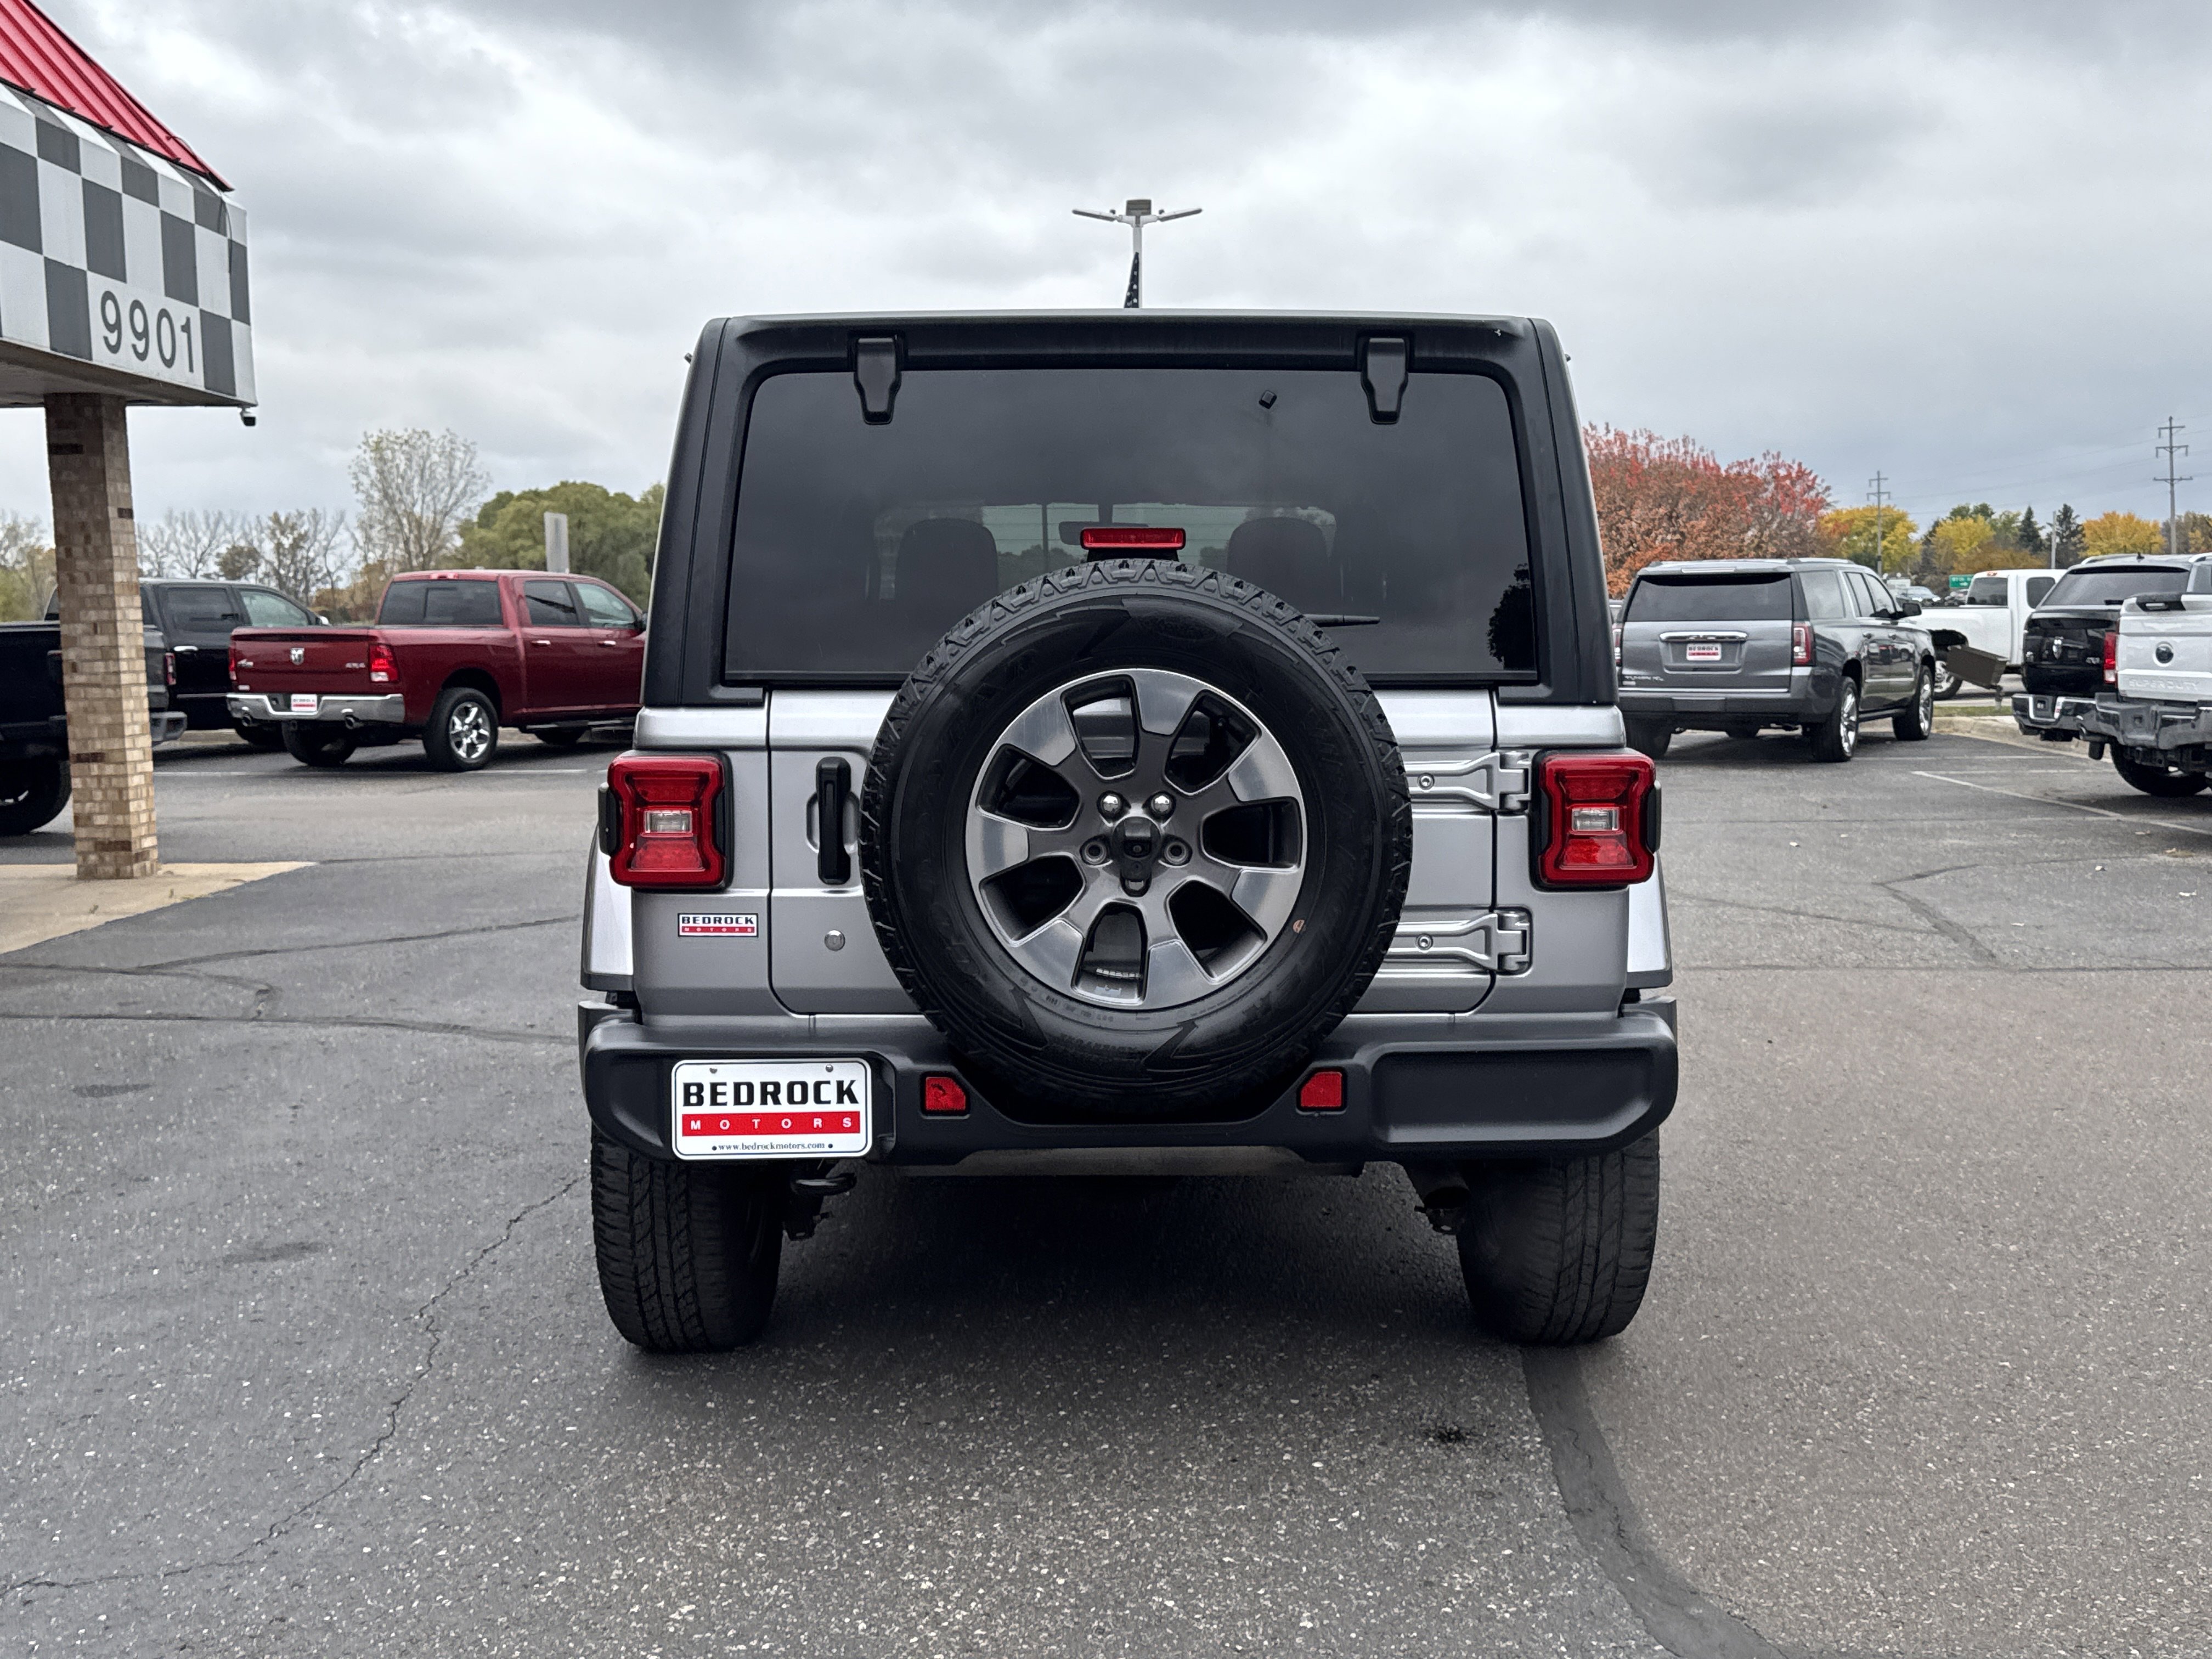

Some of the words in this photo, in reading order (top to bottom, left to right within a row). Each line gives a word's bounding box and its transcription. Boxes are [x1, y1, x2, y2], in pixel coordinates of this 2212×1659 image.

[100, 290, 194, 374] 9901
[681, 916, 754, 925] BEDROCK
[682, 1080, 859, 1107] BEDROCK
[690, 1117, 852, 1130] MOTORS
[718, 1142, 825, 1151] www.bedrockmotors.com
